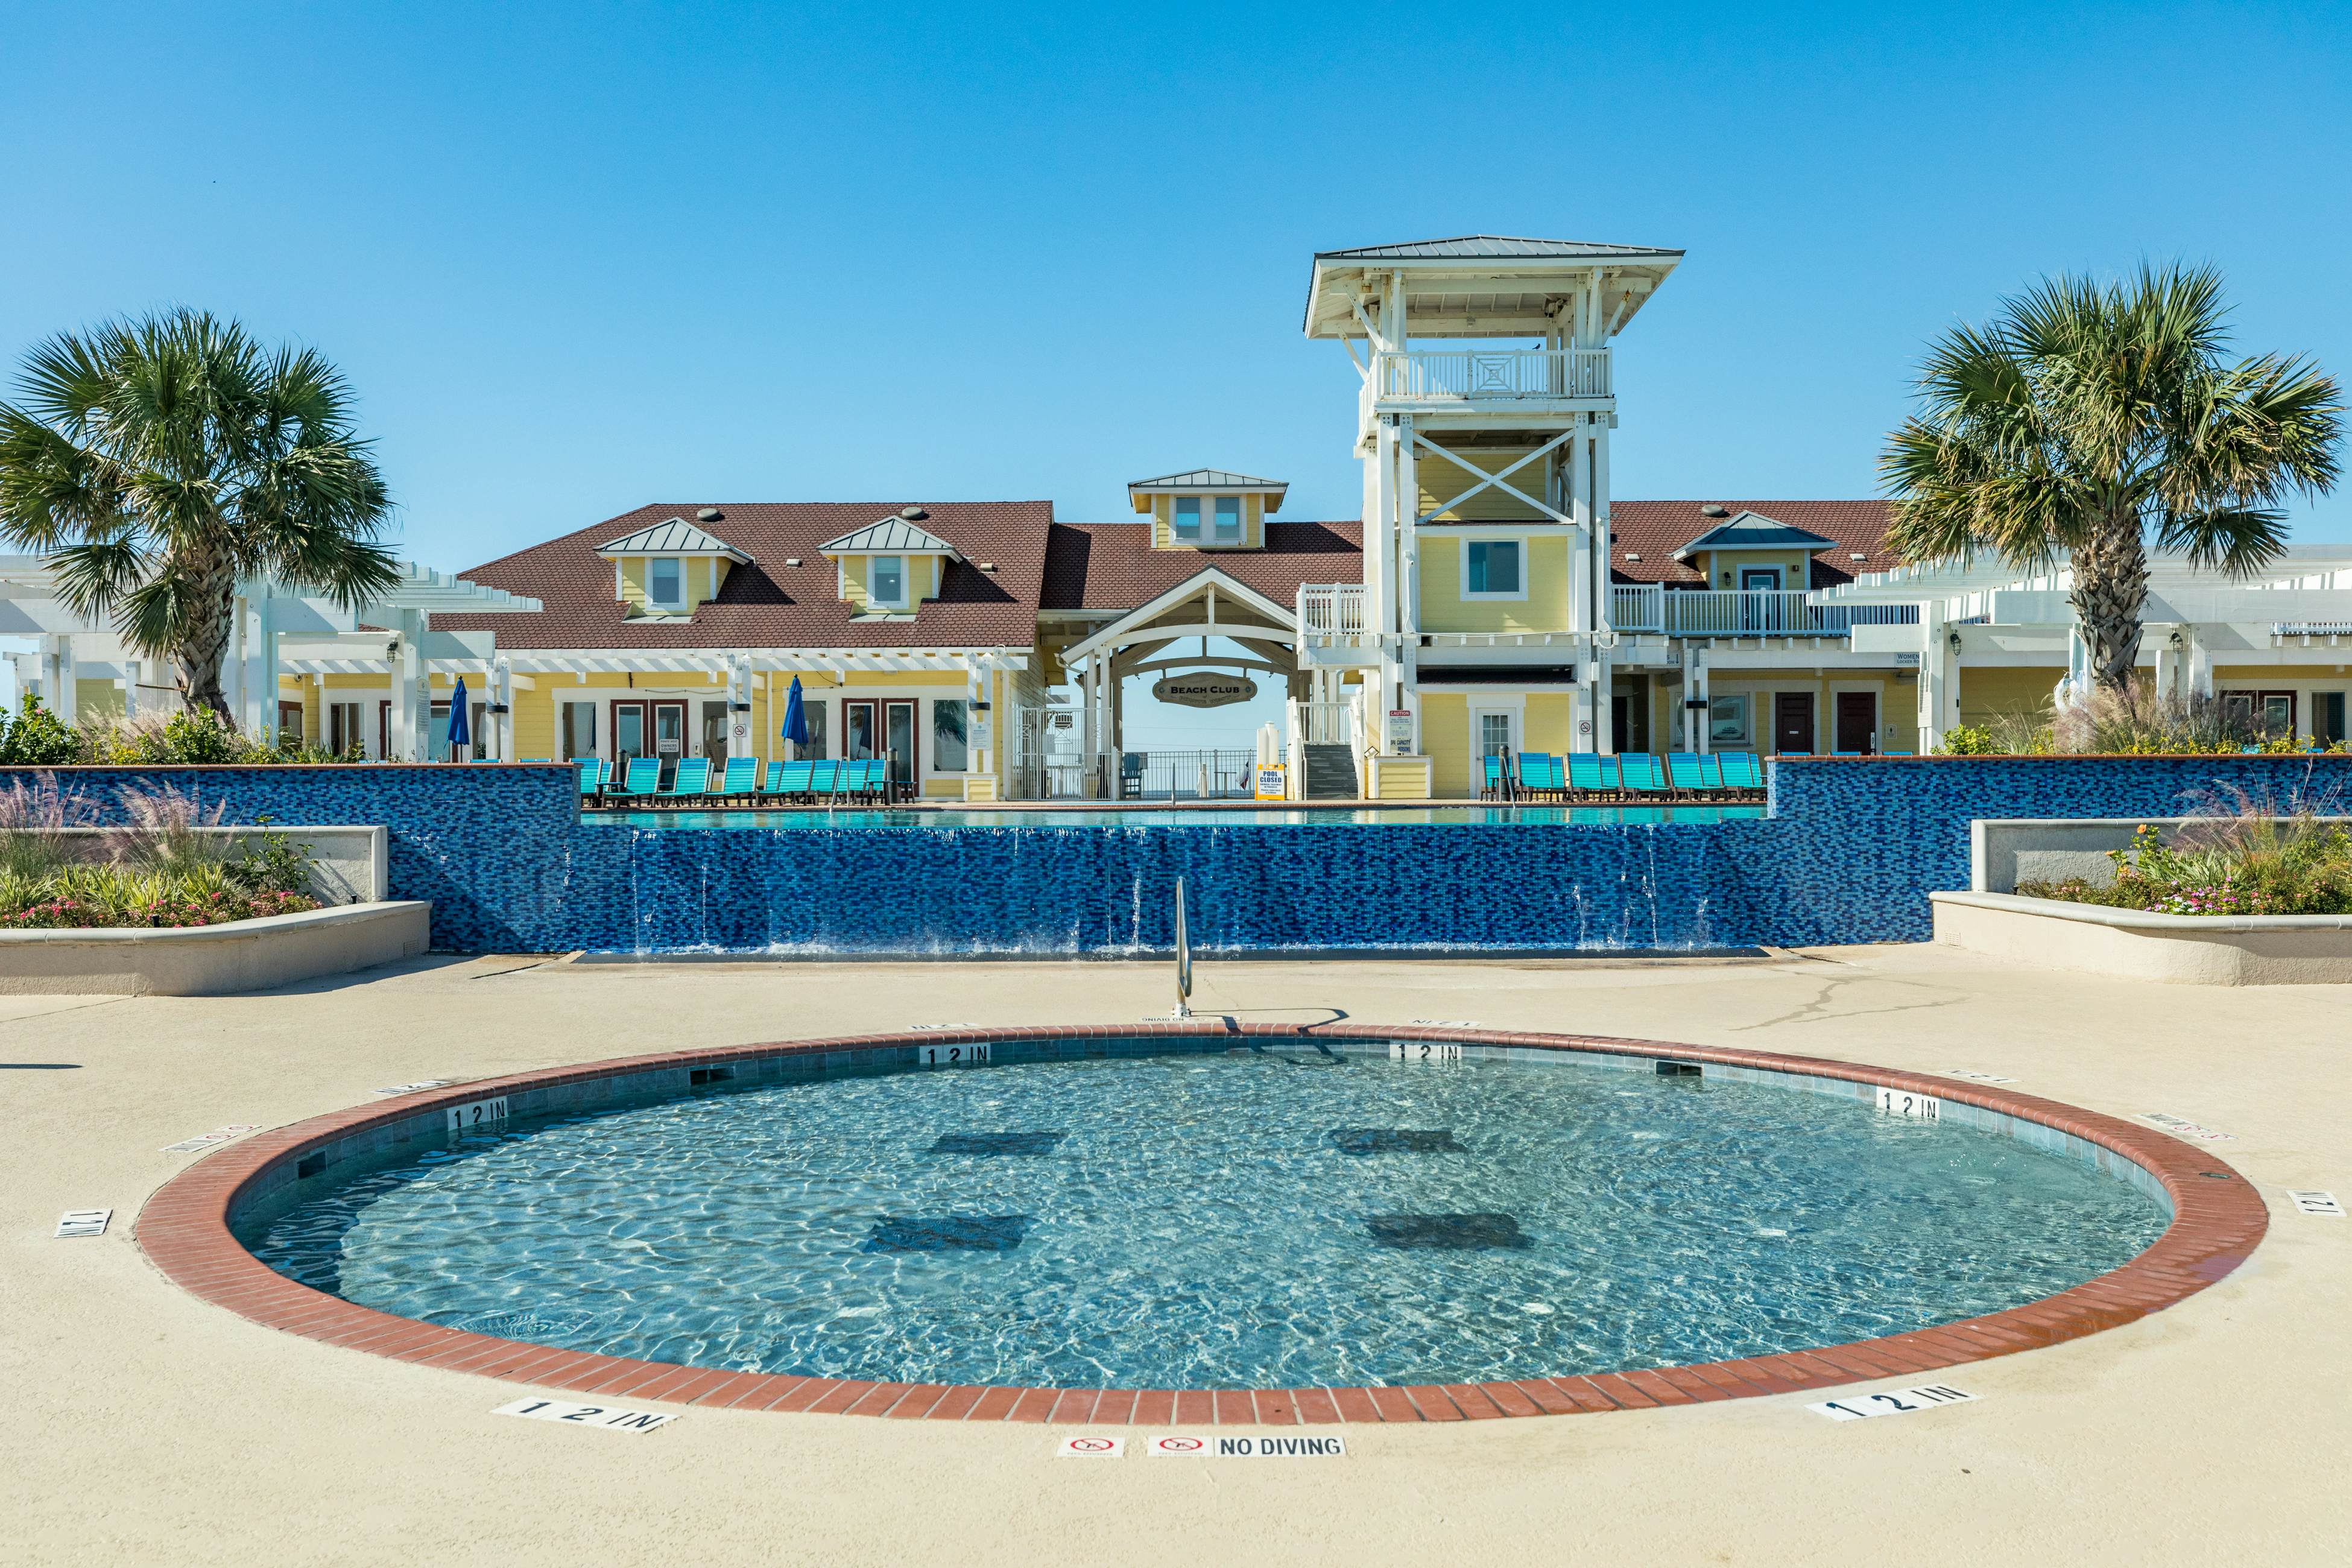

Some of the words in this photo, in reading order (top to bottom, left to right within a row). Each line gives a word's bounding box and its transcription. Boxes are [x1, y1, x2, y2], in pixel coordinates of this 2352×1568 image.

[970, 1046, 987, 1061] IN
[1441, 1046, 1457, 1060] IN
[490, 1101, 505, 1120] IN
[1921, 1099, 1936, 1118] IN
[1911, 1386, 1970, 1402] IN
[606, 1412, 666, 1428] IN
[1220, 1438, 1252, 1455] NO
[1260, 1438, 1341, 1455] DIVING
